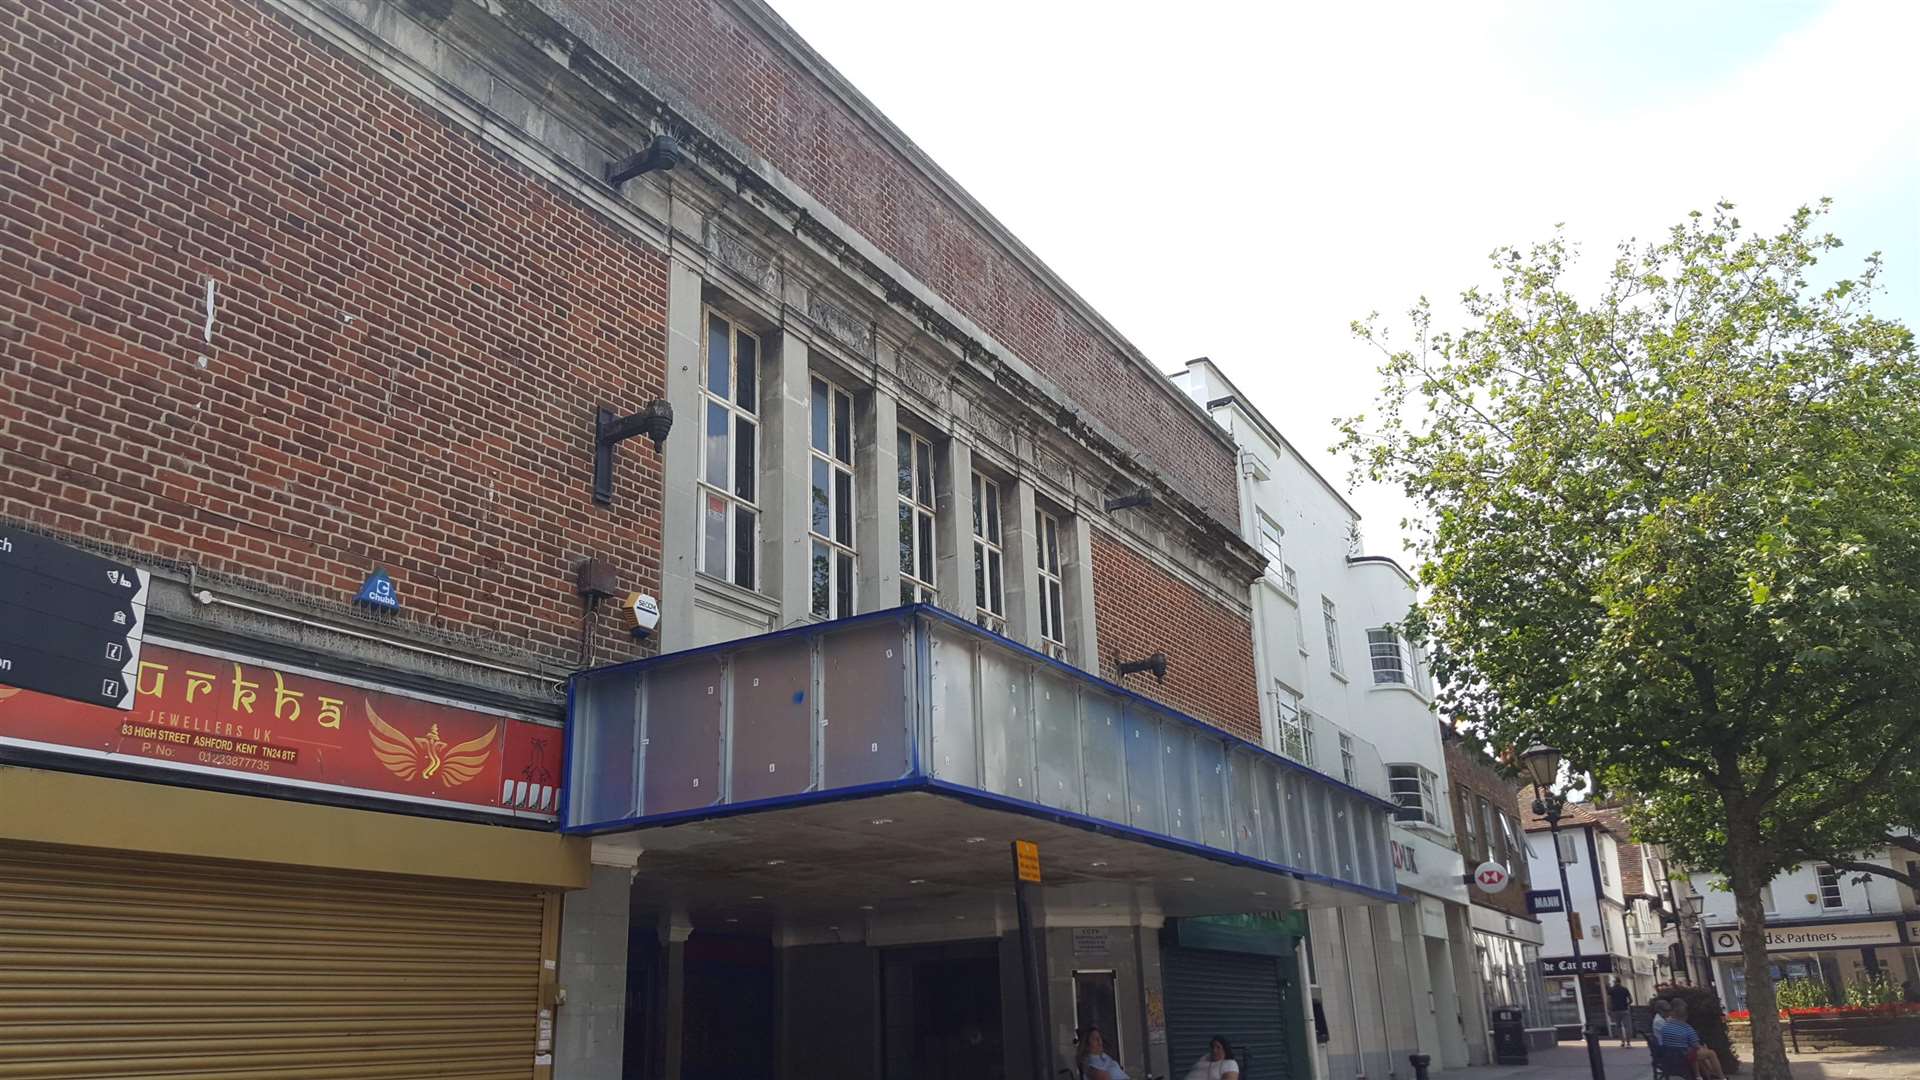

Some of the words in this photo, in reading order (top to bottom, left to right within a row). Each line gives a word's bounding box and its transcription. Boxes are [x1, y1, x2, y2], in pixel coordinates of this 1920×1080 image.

[369, 591, 396, 606] Chubb
[148, 710, 243, 737] JEWELLERS
[254, 728, 272, 743] UK
[121, 723, 133, 735] 83
[134, 726, 157, 739] HIGH
[158, 729, 191, 744] STREET
[193, 735, 233, 751] ASHFORD
[236, 743, 258, 755] KENT
[262, 746, 281, 759] TN24
[281, 750, 297, 761] 8TF
[198, 751, 270, 771] 01233877735
[1774, 934, 1786, 944] &
[1787, 932, 1838, 943] Partners
[1558, 960, 1598, 971] Carery
